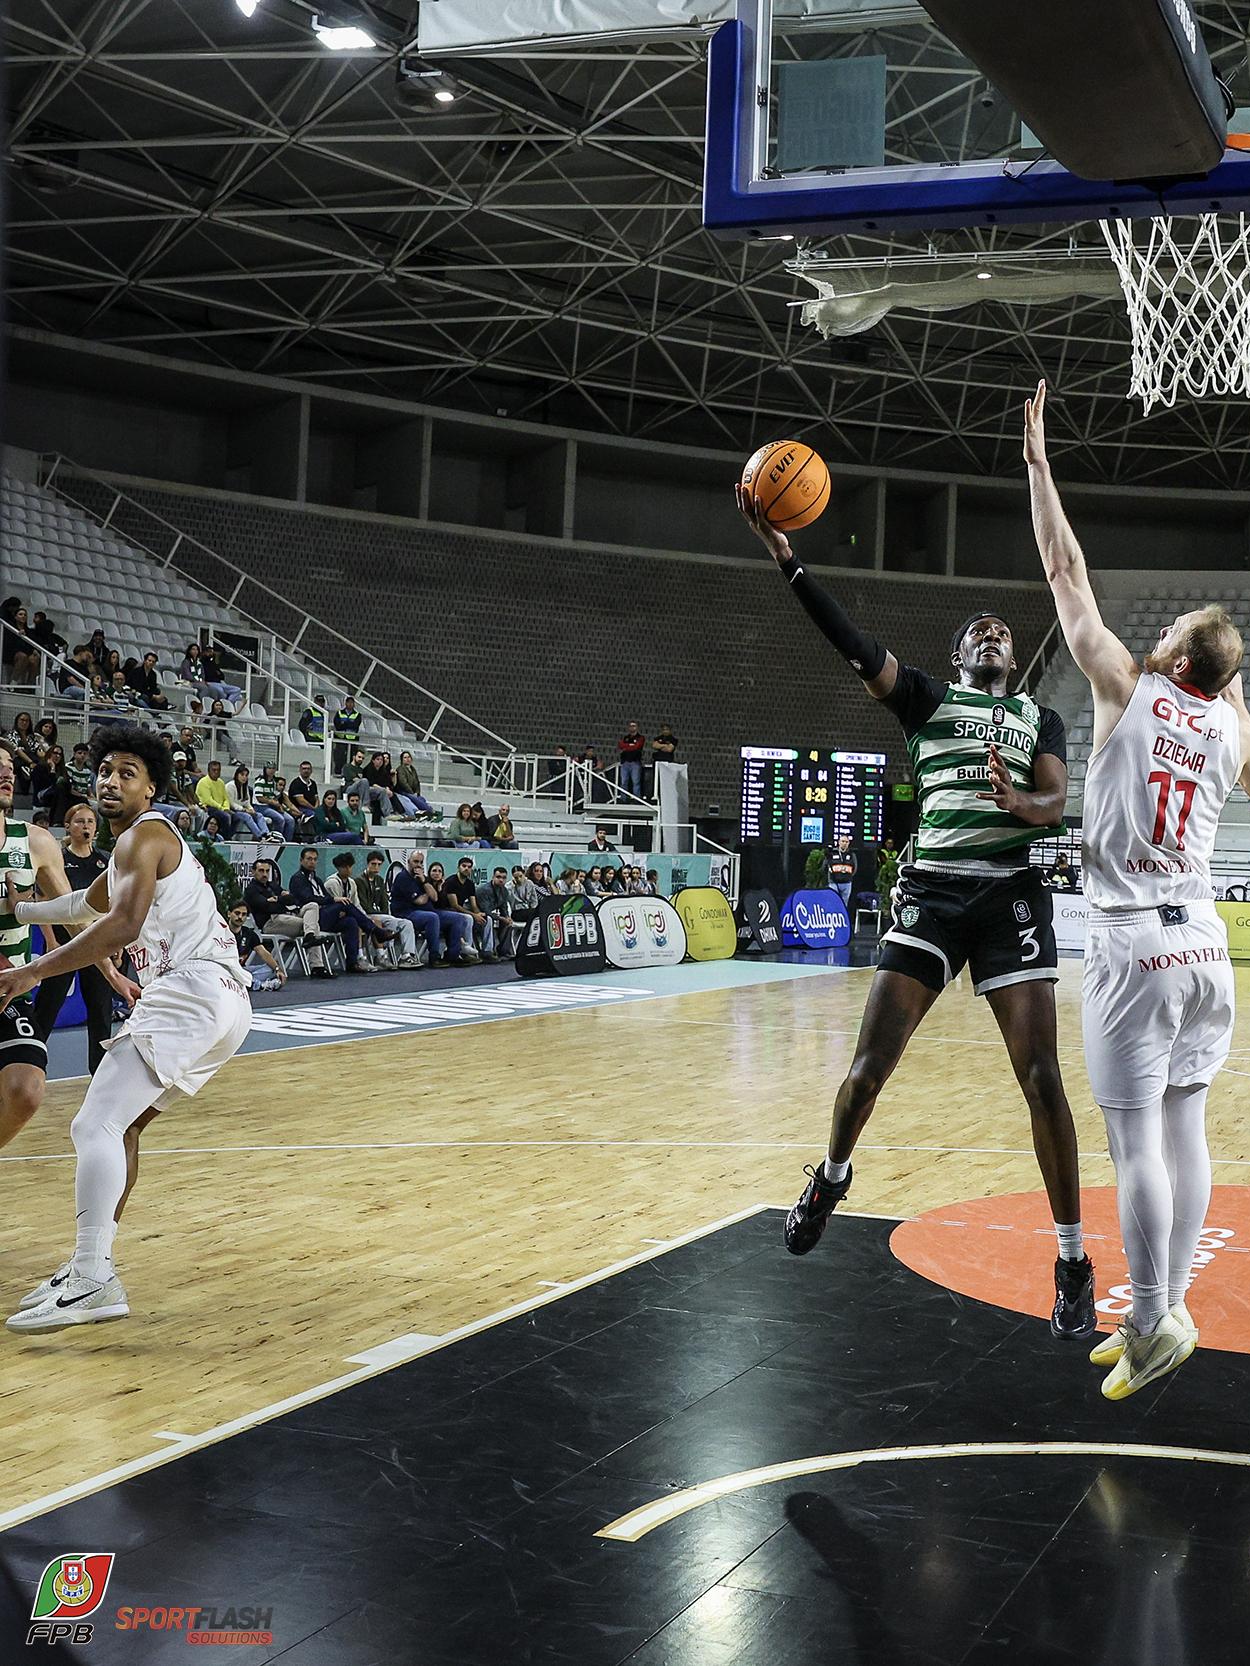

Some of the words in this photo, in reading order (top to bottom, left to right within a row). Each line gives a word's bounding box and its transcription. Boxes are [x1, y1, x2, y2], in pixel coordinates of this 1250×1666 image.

[769, 452, 794, 483] EVO
[954, 721, 1033, 753] SPORTING
[1152, 735, 1206, 774] DZIEWA
[805, 787, 827, 803] 8:26
[1147, 771, 1199, 851] 11
[564, 913, 598, 946] FPB
[795, 901, 848, 939] Culligan
[1018, 926, 1040, 963] 3
[15, 1017, 35, 1037] 6
